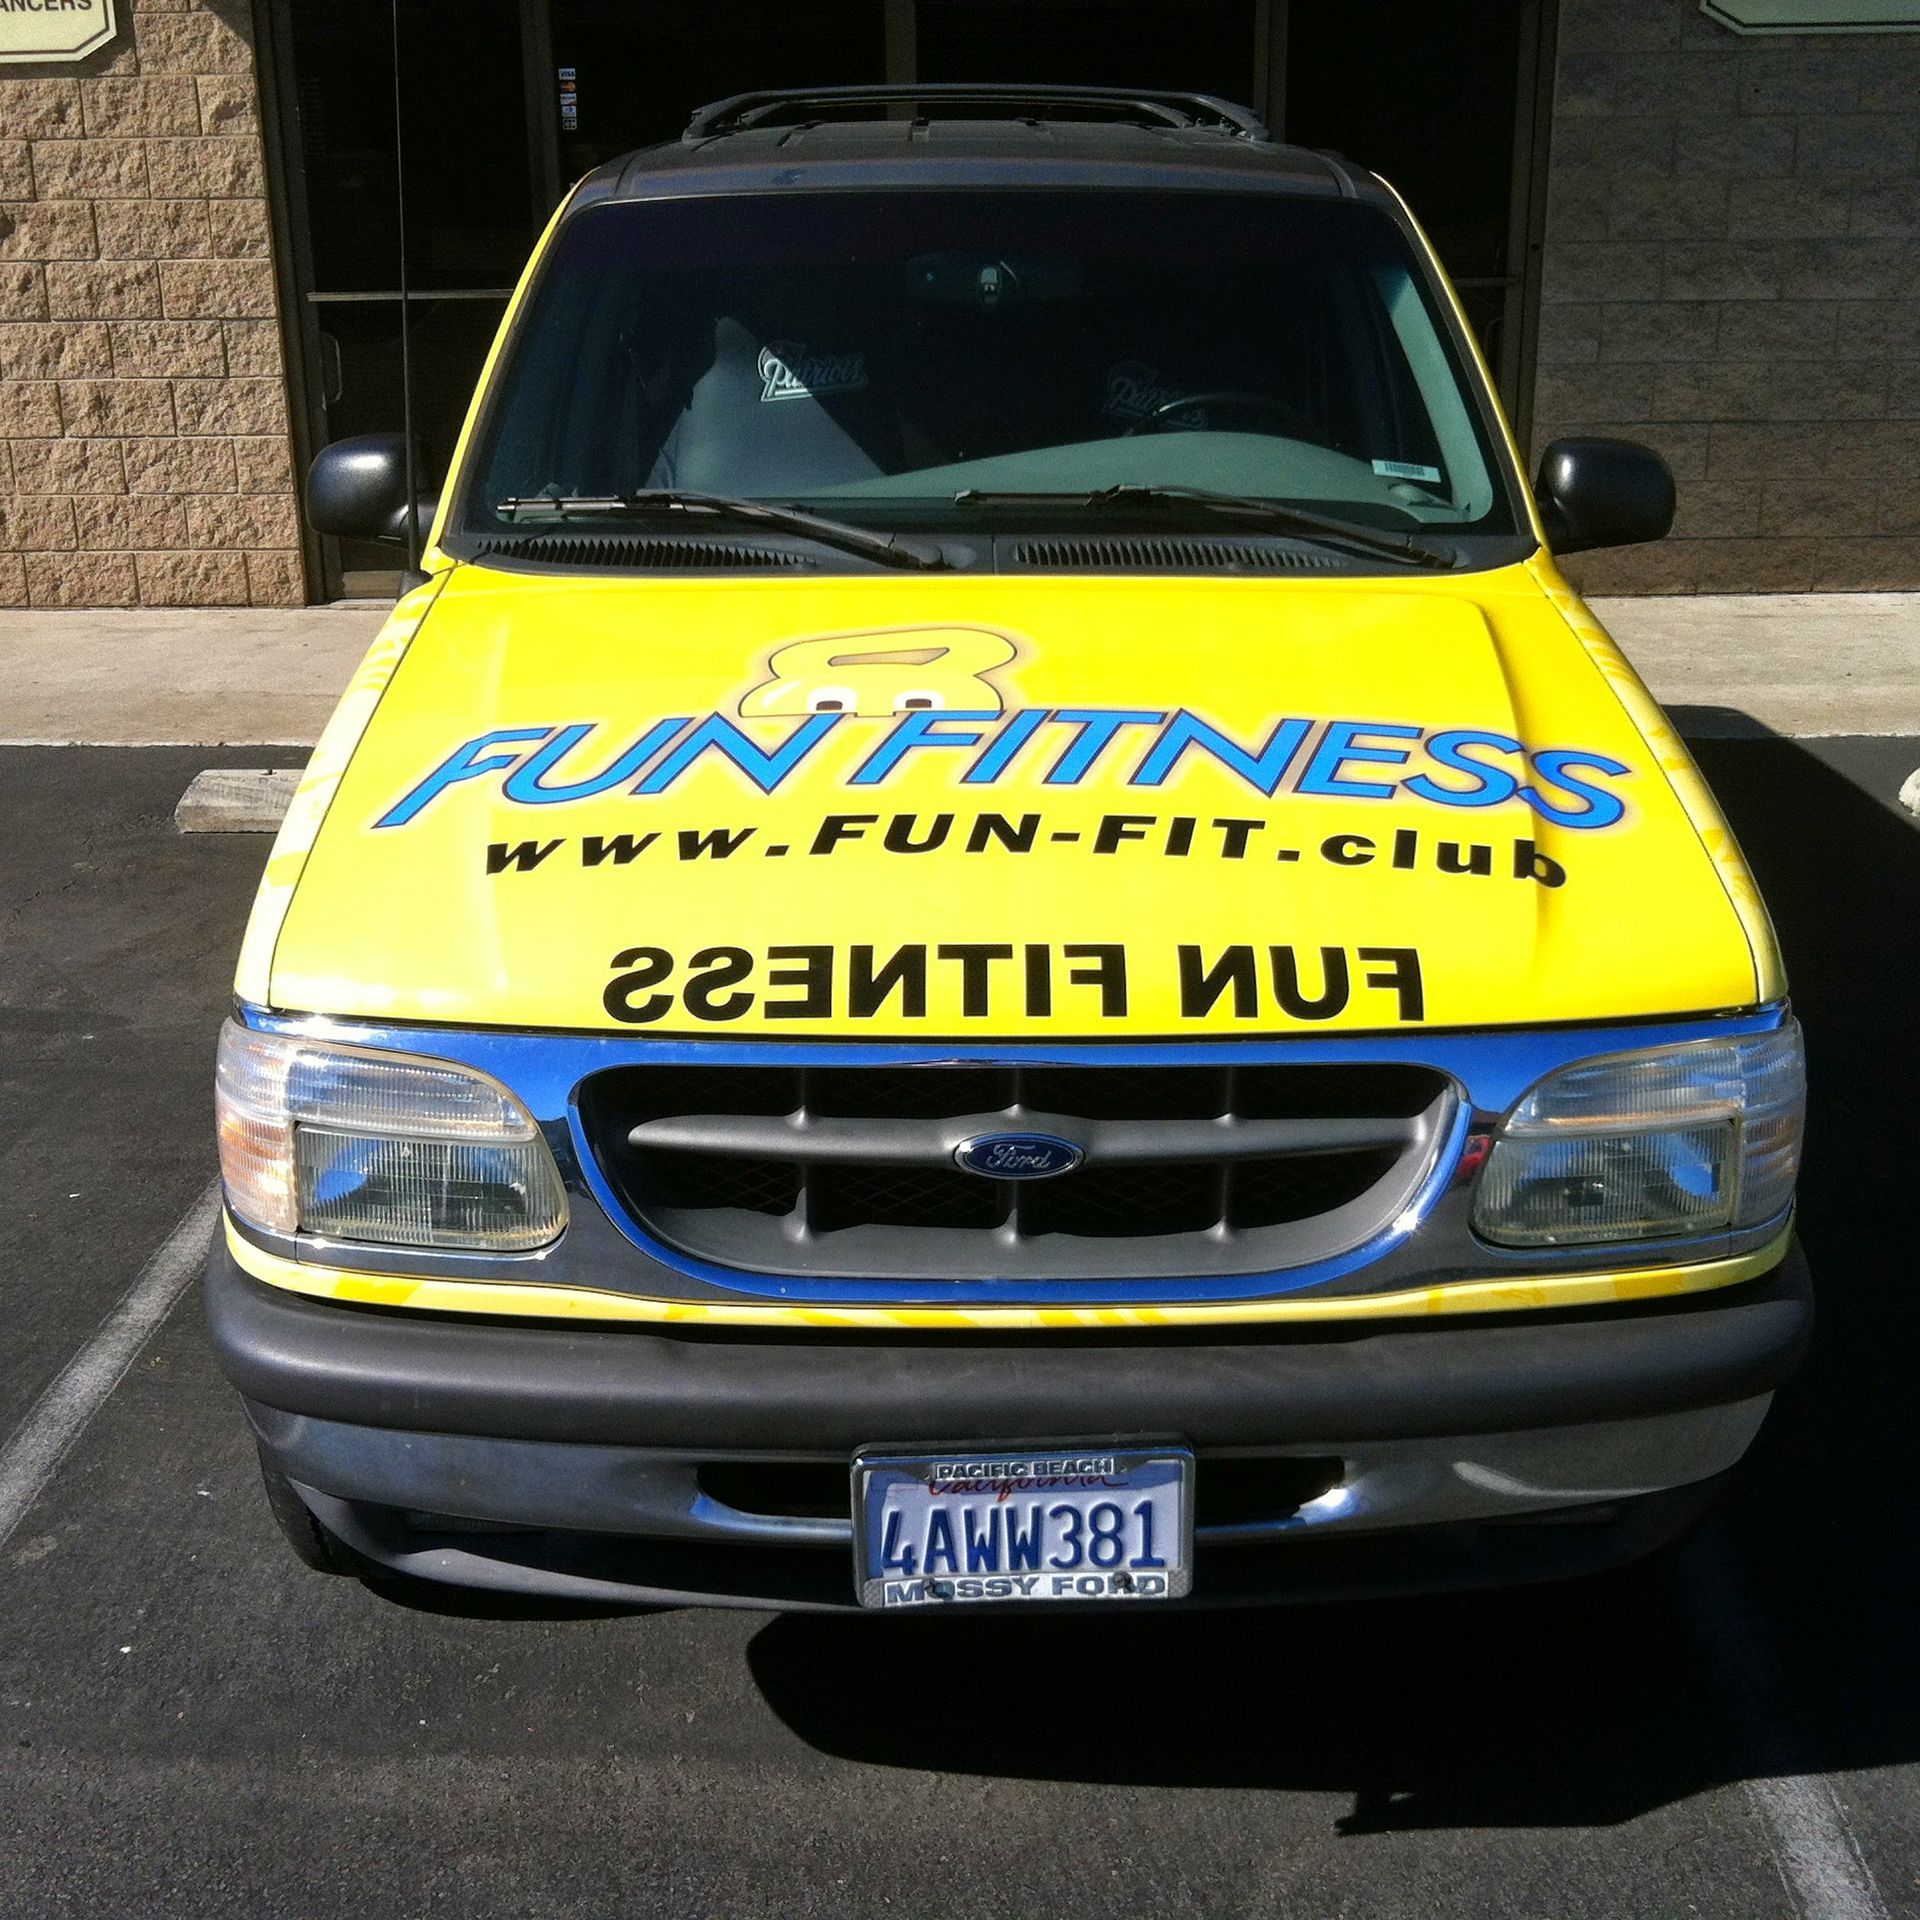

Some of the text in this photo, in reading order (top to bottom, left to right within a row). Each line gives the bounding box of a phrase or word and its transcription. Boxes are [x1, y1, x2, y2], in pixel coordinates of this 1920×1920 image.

[371, 707, 1632, 830] FUN FITNESS
[486, 813, 1567, 889] www.FUN-FIT.club
[985, 1143, 1052, 1169] Ford
[937, 1457, 1114, 1480] PACIFIC BEACH
[881, 1498, 1165, 1576] 4AWW381
